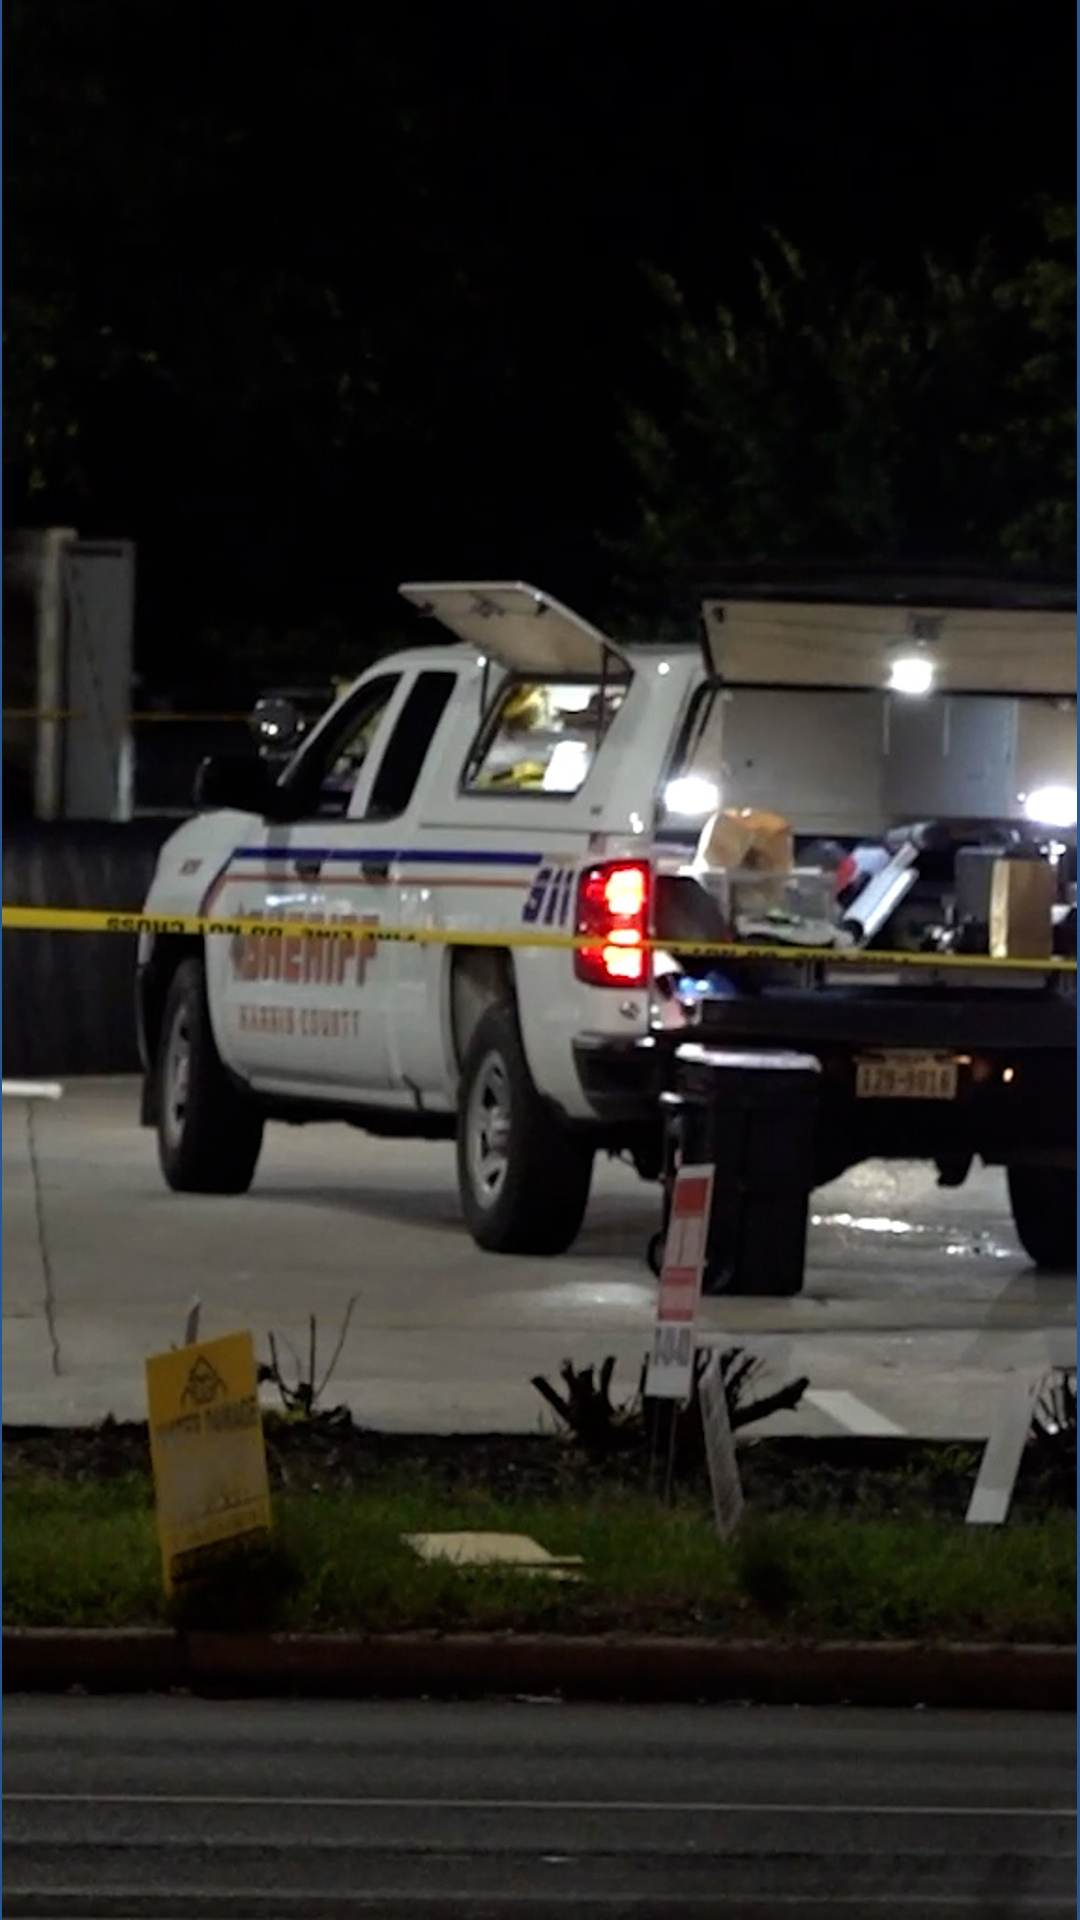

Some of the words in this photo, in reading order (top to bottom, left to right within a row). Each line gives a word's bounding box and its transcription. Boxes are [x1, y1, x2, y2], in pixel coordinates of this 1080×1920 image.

[522, 867, 574, 926] 911
[236, 909, 380, 986] SHERIFF
[301, 1008, 362, 1037] COUNTY
